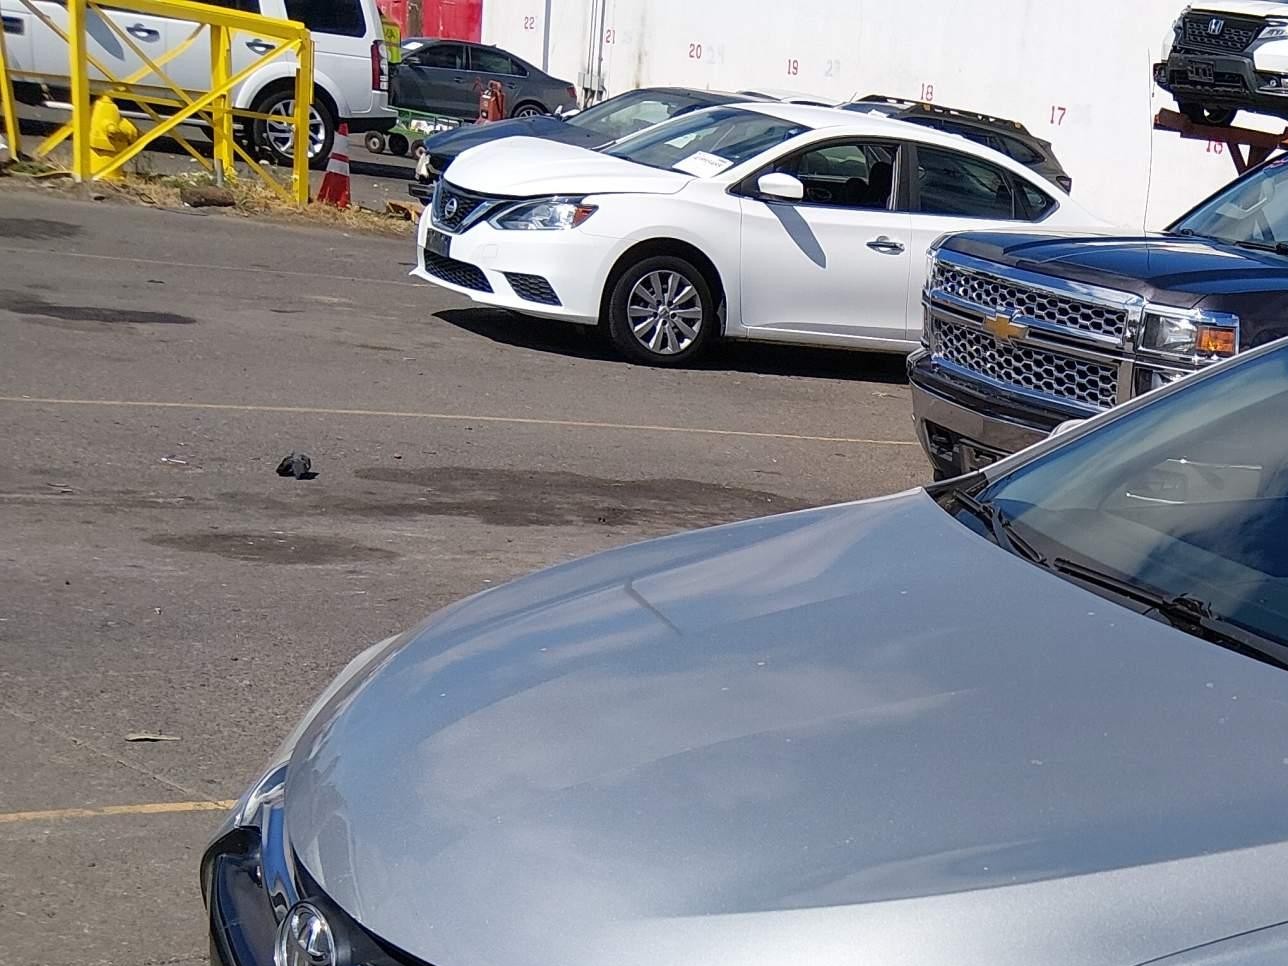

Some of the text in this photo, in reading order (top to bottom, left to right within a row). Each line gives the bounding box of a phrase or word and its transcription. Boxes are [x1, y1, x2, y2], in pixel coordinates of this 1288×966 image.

[524, 16, 535, 29] 22
[605, 29, 616, 44] 21
[688, 43, 702, 59] 20
[787, 58, 799, 76] 19
[921, 82, 934, 101] 18
[1050, 105, 1066, 126] 17
